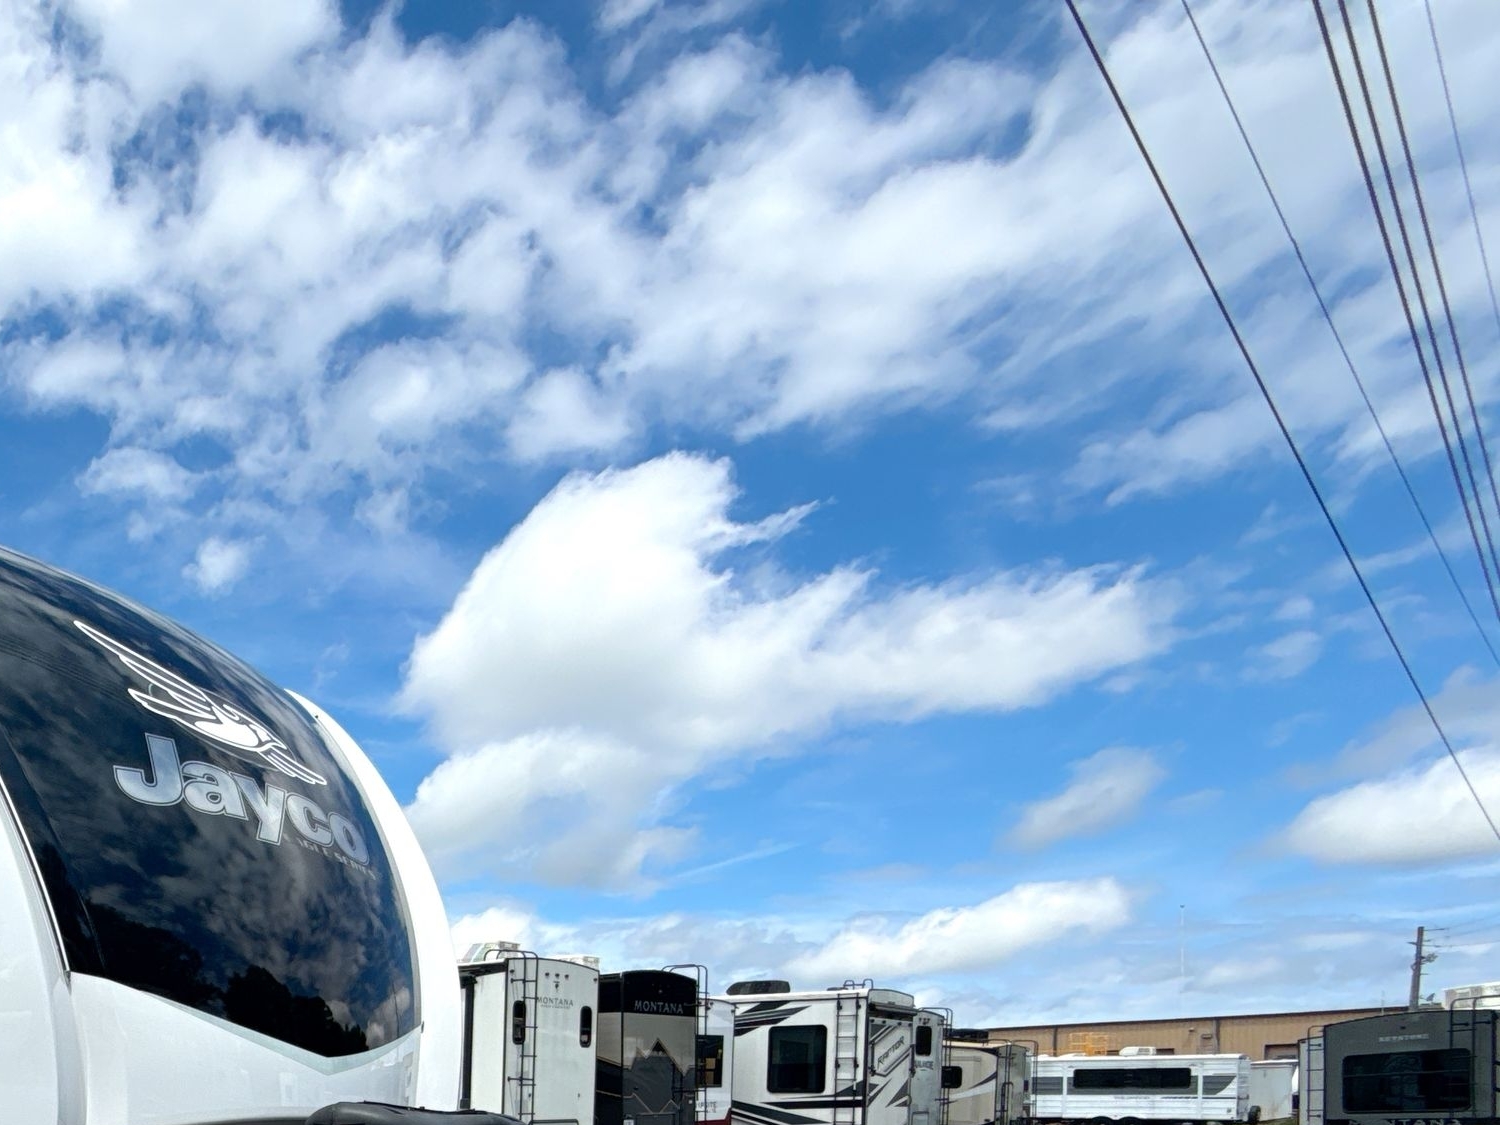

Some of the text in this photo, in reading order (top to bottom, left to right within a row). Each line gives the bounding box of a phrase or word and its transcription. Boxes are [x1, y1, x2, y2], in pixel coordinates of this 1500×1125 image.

[112, 732, 370, 867] Jayco
[537, 996, 574, 1007] MONTANA
[634, 1000, 684, 1014] MONTANA
[877, 1035, 905, 1070] RAPTOR
